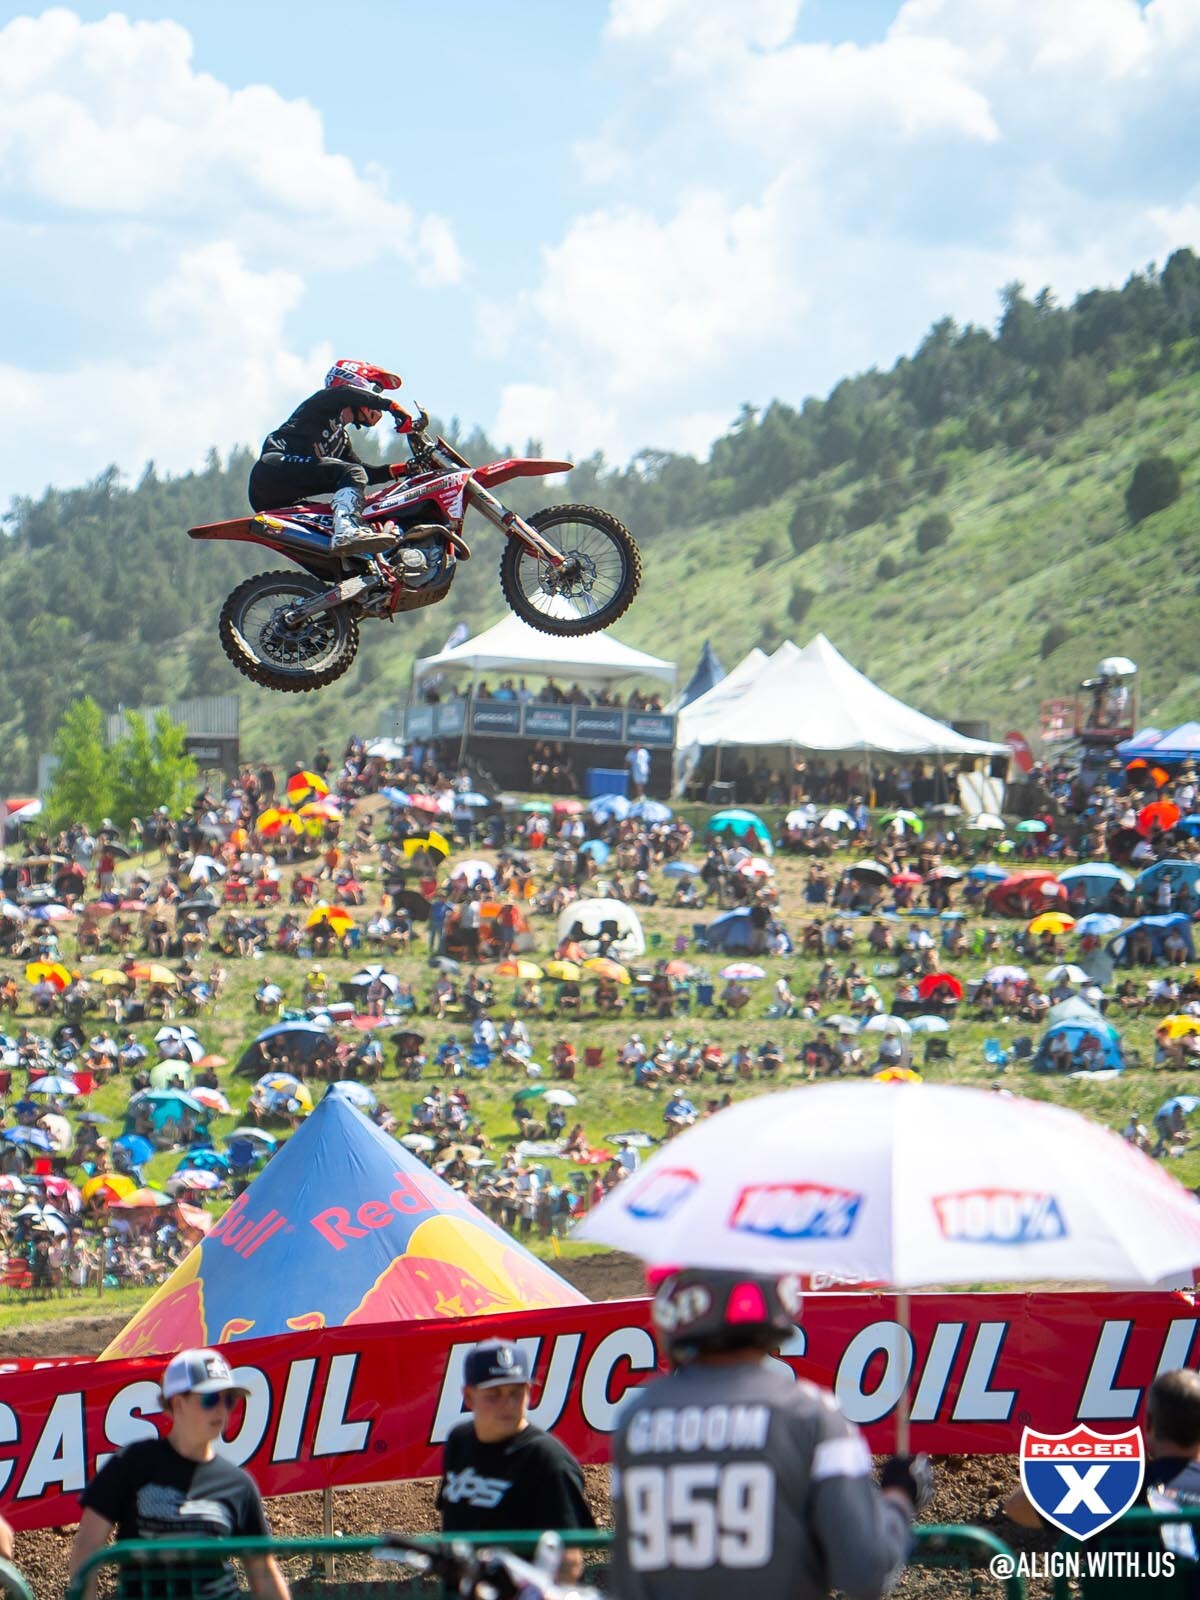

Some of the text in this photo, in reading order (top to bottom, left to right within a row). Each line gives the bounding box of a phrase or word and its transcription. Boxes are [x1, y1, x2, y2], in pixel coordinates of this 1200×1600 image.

[206, 1192, 287, 1260] Bull
[310, 1172, 434, 1250] Red
[938, 1193, 1065, 1241] 100%
[835, 1320, 1018, 1423] OIL
[627, 1404, 771, 1455] GROOM
[625, 1462, 775, 1571] 959
